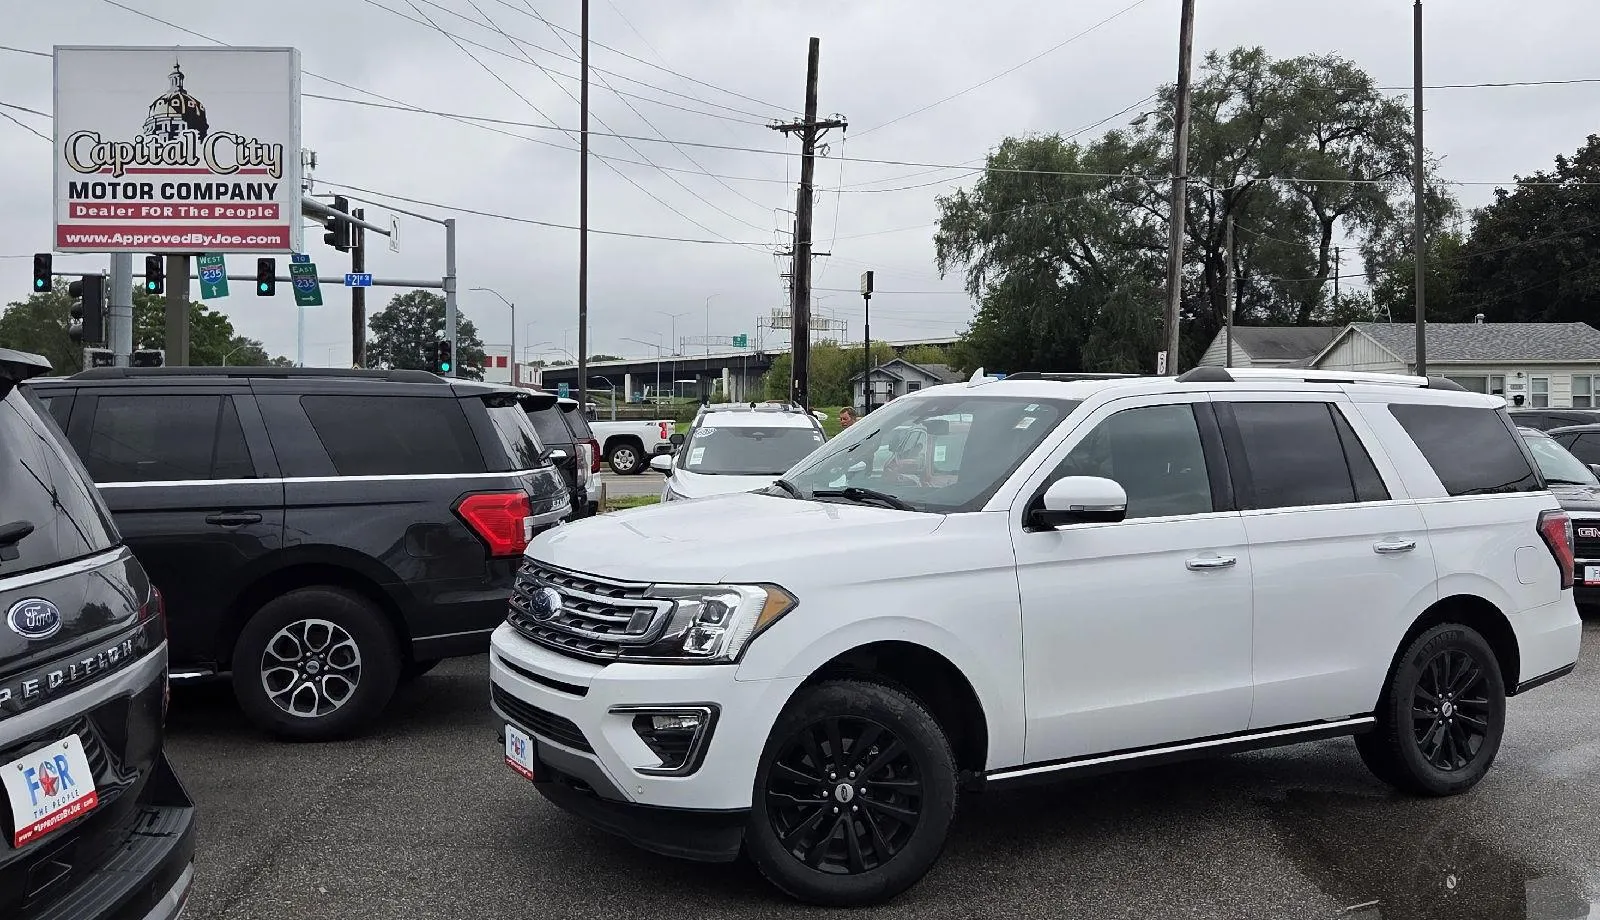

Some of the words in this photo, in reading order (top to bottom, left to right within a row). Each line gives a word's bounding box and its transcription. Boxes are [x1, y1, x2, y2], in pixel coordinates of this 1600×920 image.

[64, 129, 200, 178] Capital
[203, 130, 283, 178] City
[68, 181, 154, 200] MOTOR
[160, 182, 279, 201] COMPANY
[76, 205, 134, 217] Dealer
[141, 206, 173, 217] FOR
[178, 206, 209, 217] The
[214, 206, 274, 219] People
[66, 232, 281, 246] www.ApprovedByJoe.com
[199, 256, 221, 264] WEST
[203, 269, 222, 279] 235
[292, 266, 313, 274] EAST
[296, 279, 315, 288] 235
[24, 605, 54, 629] Ford
[510, 733, 526, 761] FOR
[23, 754, 76, 806] FOR
[33, 806, 48, 819] THE
[52, 788, 81, 809] PEOPLE
